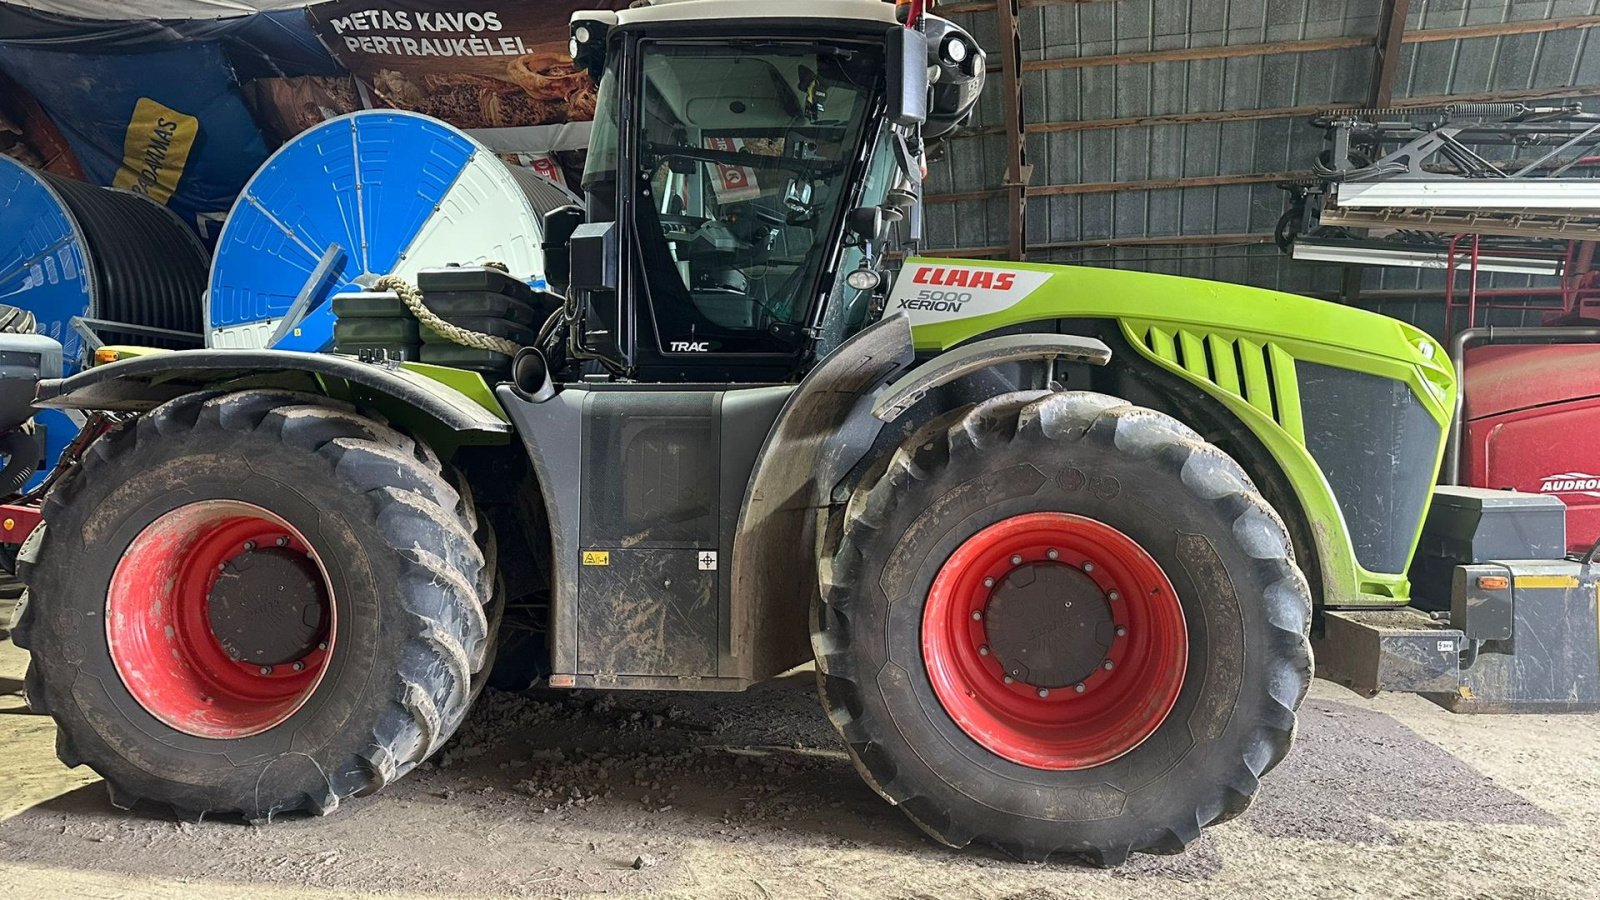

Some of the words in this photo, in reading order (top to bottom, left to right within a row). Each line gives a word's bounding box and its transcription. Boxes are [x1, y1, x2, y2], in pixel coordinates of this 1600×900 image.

[330, 9, 413, 35] METAS
[415, 11, 503, 32] KAVOS
[343, 34, 534, 57] PERTRAUKĖLEI.
[912, 267, 1016, 291] CLAAS
[897, 298, 962, 313] XERION
[917, 289, 972, 303] 5000
[670, 341, 709, 352] TRAC
